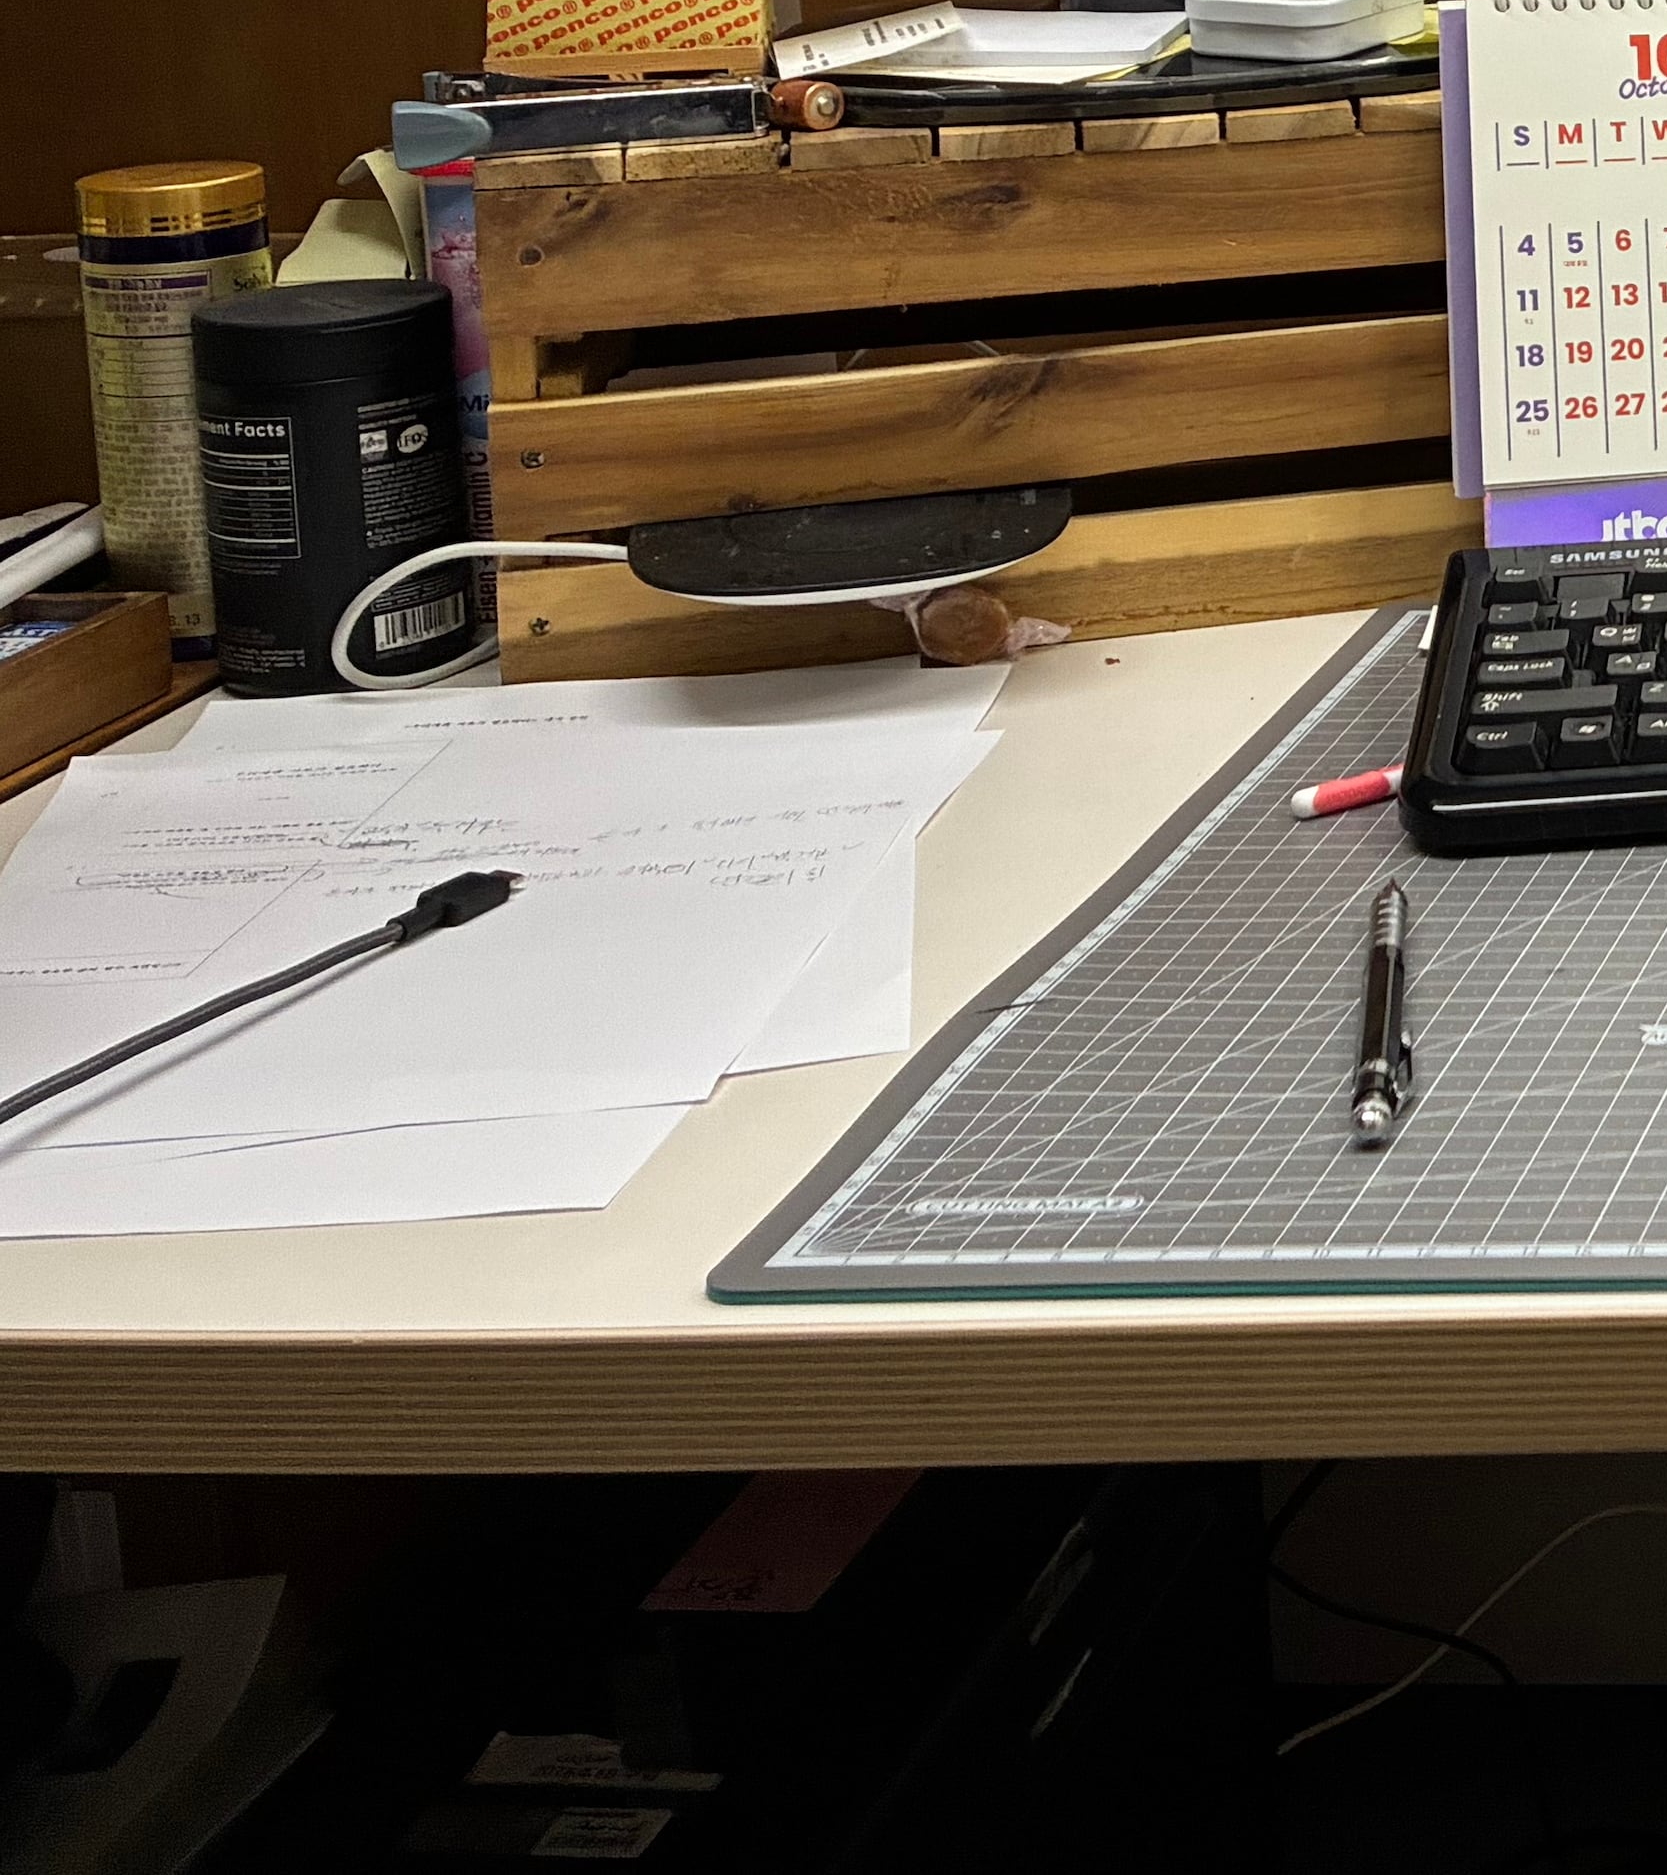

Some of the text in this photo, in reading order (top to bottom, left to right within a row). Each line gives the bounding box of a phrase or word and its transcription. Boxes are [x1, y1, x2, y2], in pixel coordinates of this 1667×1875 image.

[1513, 125, 1531, 147] S
[1558, 123, 1583, 144] M
[1610, 122, 1627, 143] T
[1515, 399, 1549, 423] 25
[1564, 395, 1598, 419] 26
[1614, 393, 1646, 416] 27
[236, 420, 286, 438] Facts
[1482, 692, 1523, 702] Shift
[1475, 731, 1508, 742] Ctrl
